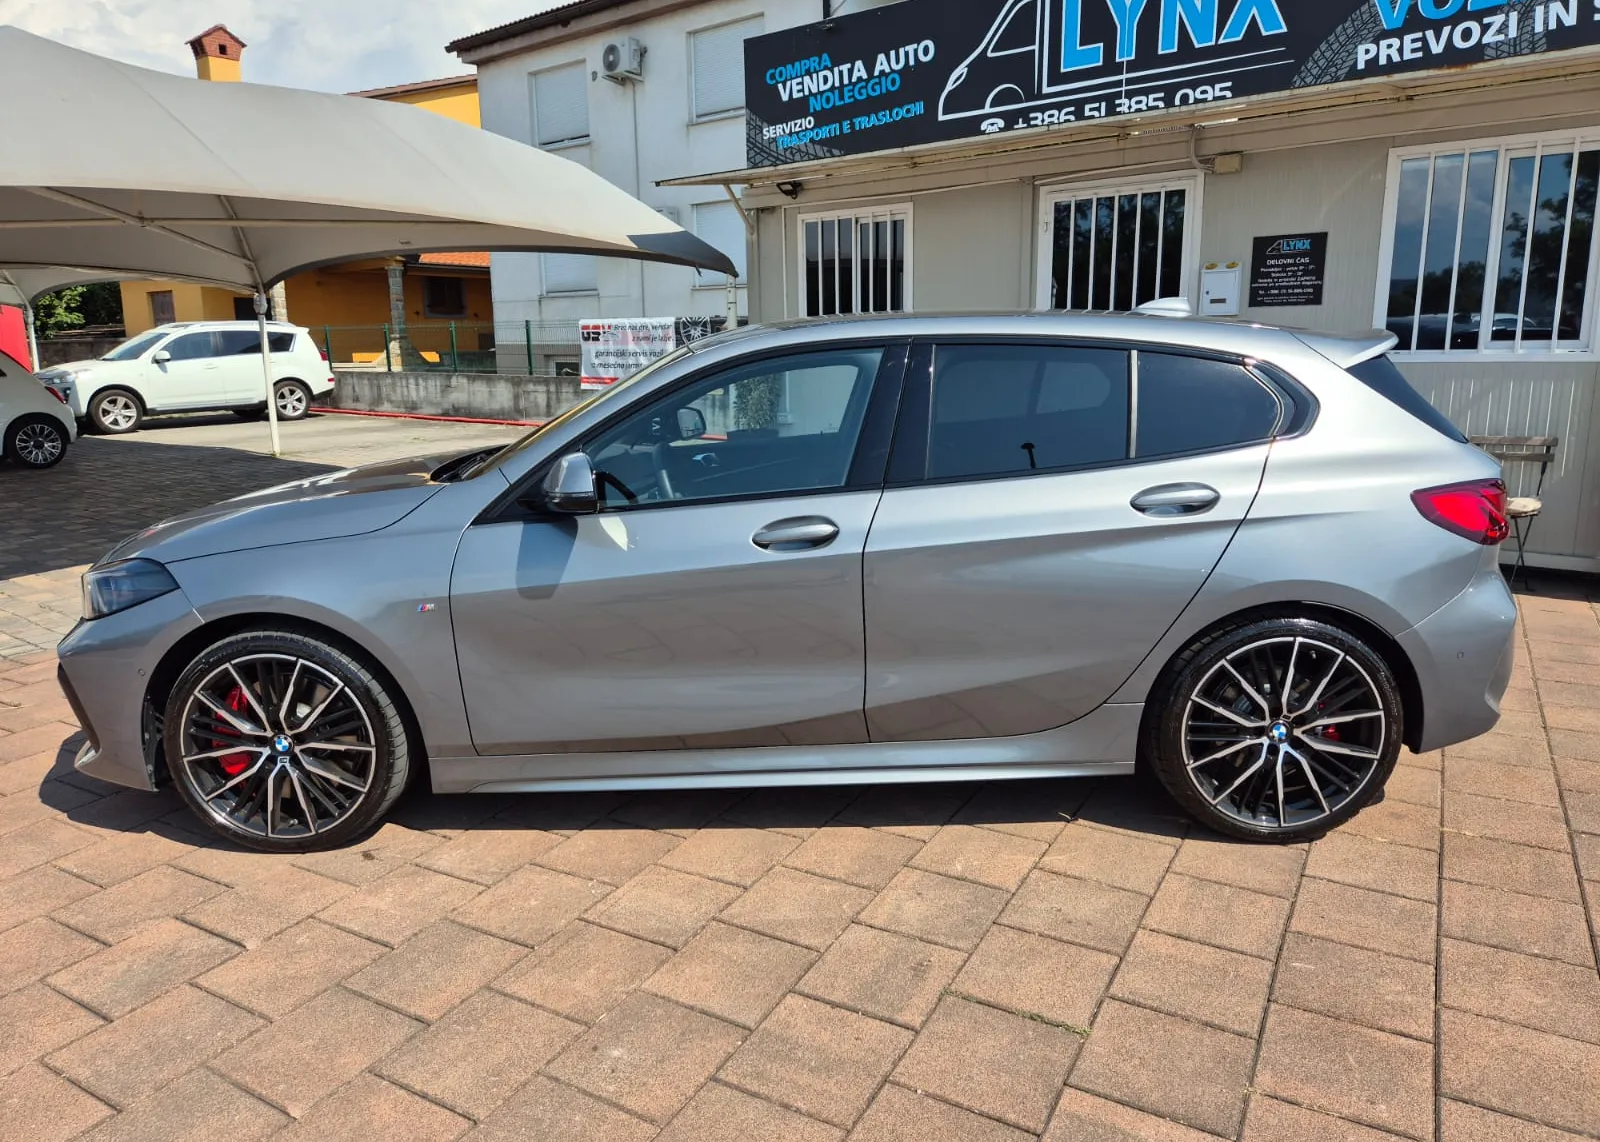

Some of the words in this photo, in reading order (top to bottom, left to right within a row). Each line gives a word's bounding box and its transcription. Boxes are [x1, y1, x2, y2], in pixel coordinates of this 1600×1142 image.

[1356, 11, 1519, 70] PREVOZI
[1534, 0, 1578, 33] IN
[765, 52, 832, 85] COMPRA
[777, 59, 868, 102] VENDITA
[873, 39, 936, 77] AUTO
[808, 73, 901, 114] NOLEGGIO
[762, 116, 815, 140] SERVIZIO
[776, 124, 840, 149] TRASPORTI
[842, 120, 851, 134] E
[853, 101, 925, 131] TRASLOCHI
